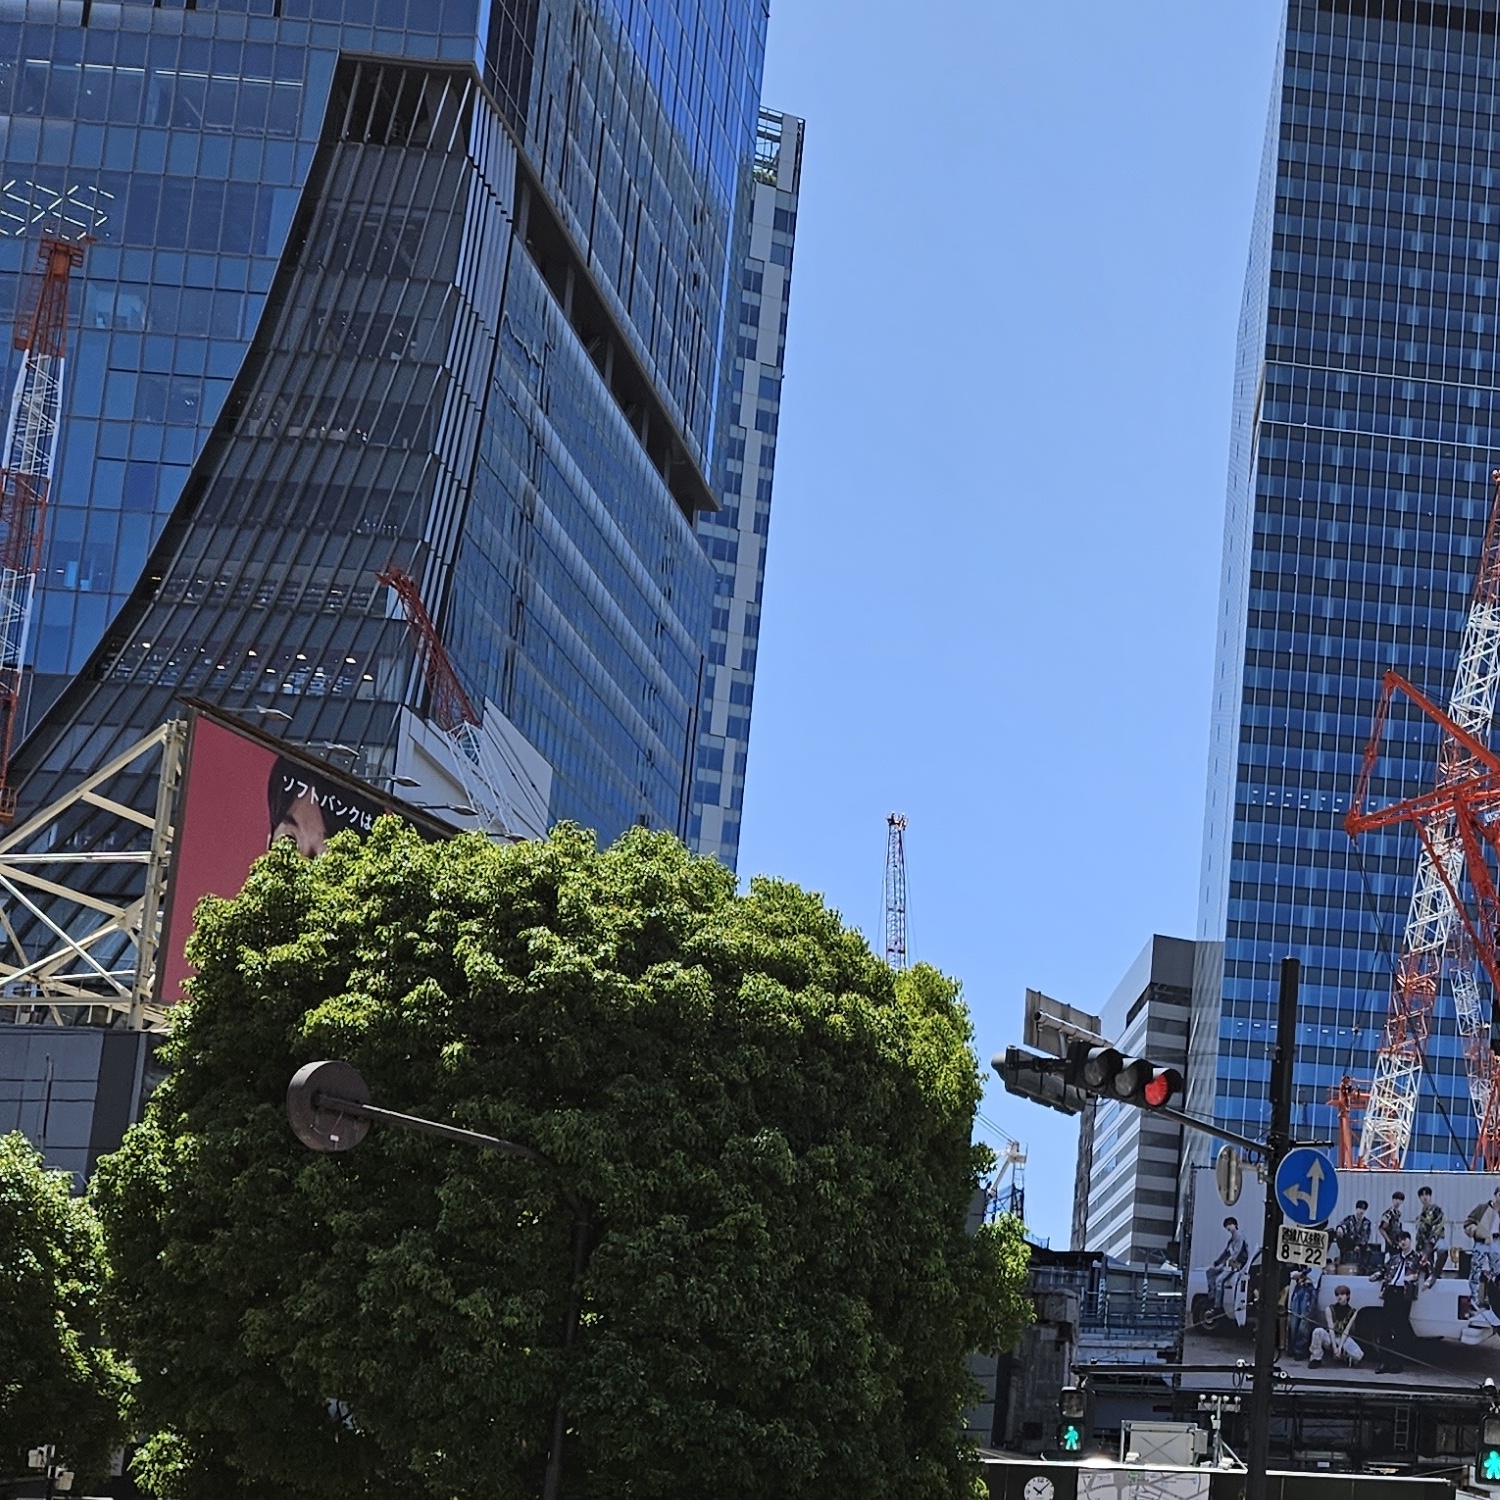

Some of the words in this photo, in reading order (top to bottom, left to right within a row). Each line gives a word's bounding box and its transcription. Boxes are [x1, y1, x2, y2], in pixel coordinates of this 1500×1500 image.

[283, 775, 373, 831] ソフトバンクは
